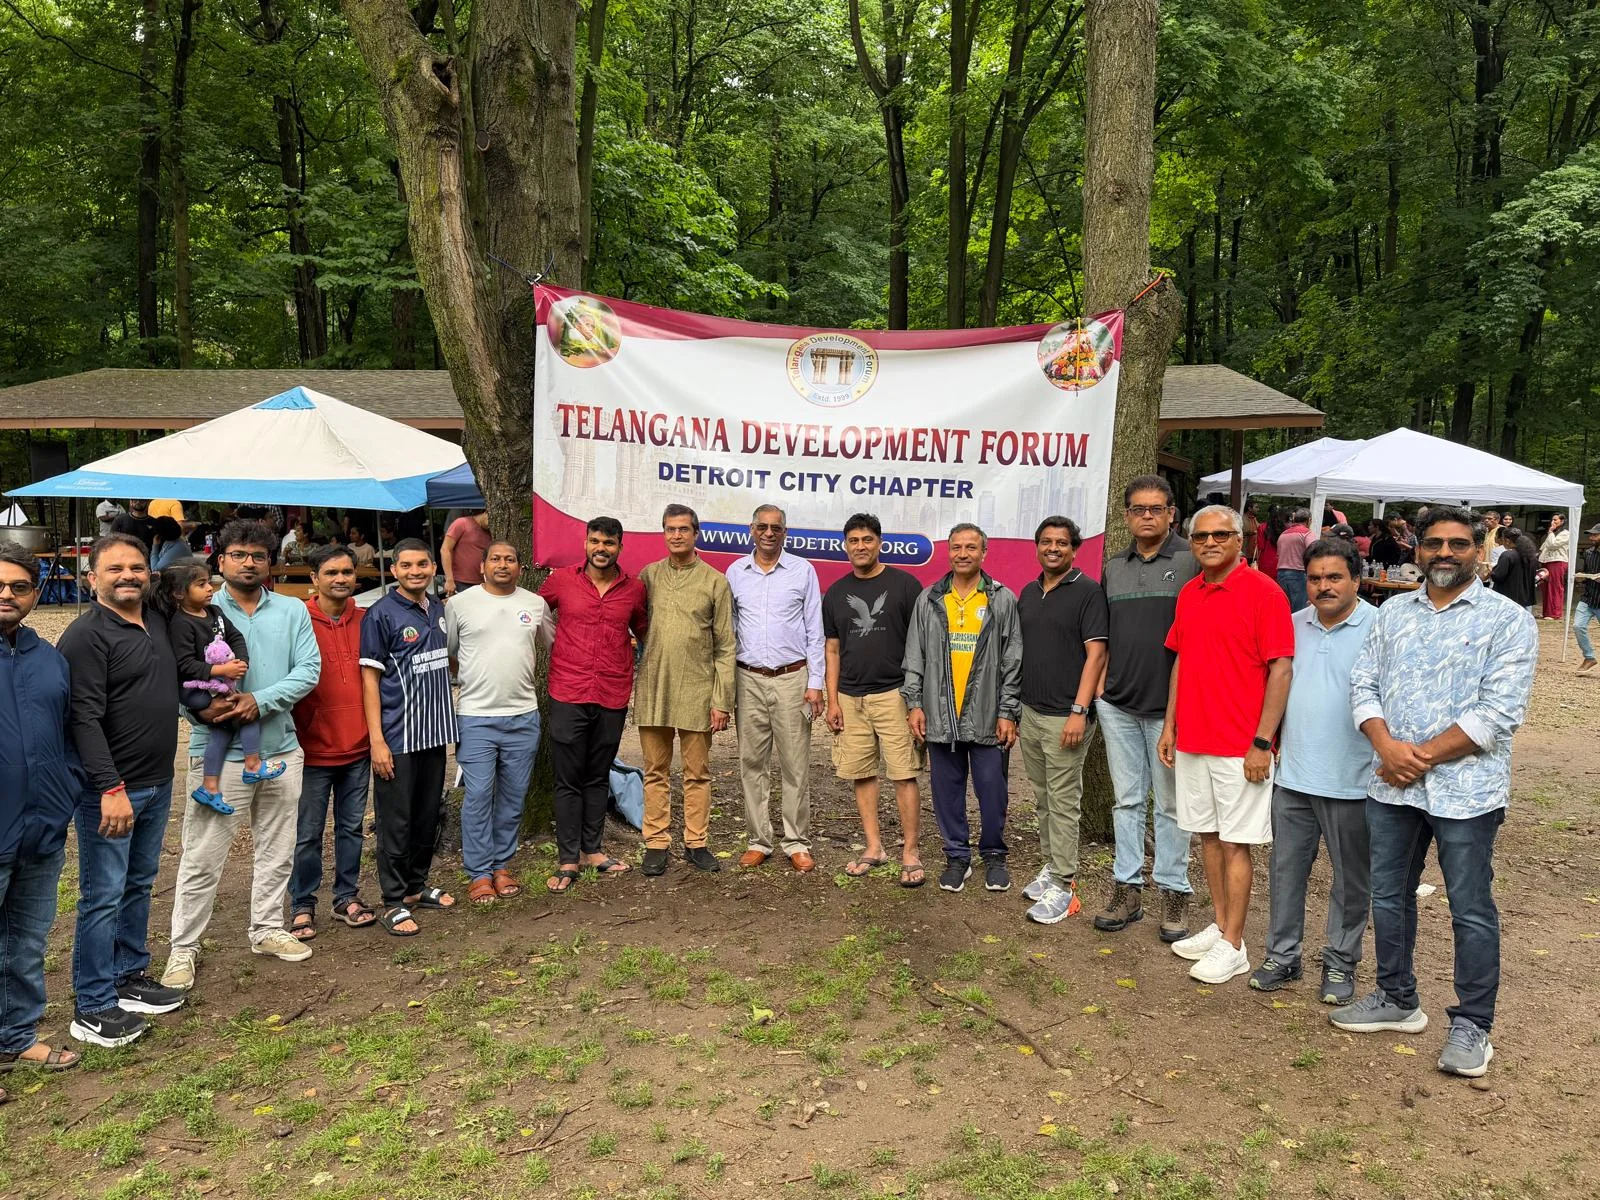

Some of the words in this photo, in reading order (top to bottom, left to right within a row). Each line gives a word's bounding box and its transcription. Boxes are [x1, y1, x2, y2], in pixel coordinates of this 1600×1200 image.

[810, 335, 870, 355] Development
[862, 353, 875, 383] Forum
[557, 403, 731, 452] TELANGANA
[741, 420, 970, 463] DEVELOPMENT
[978, 430, 1090, 467] FORUM
[658, 461, 771, 489] DETROIT
[779, 471, 841, 493] CITY
[850, 475, 974, 499] CHAPTER
